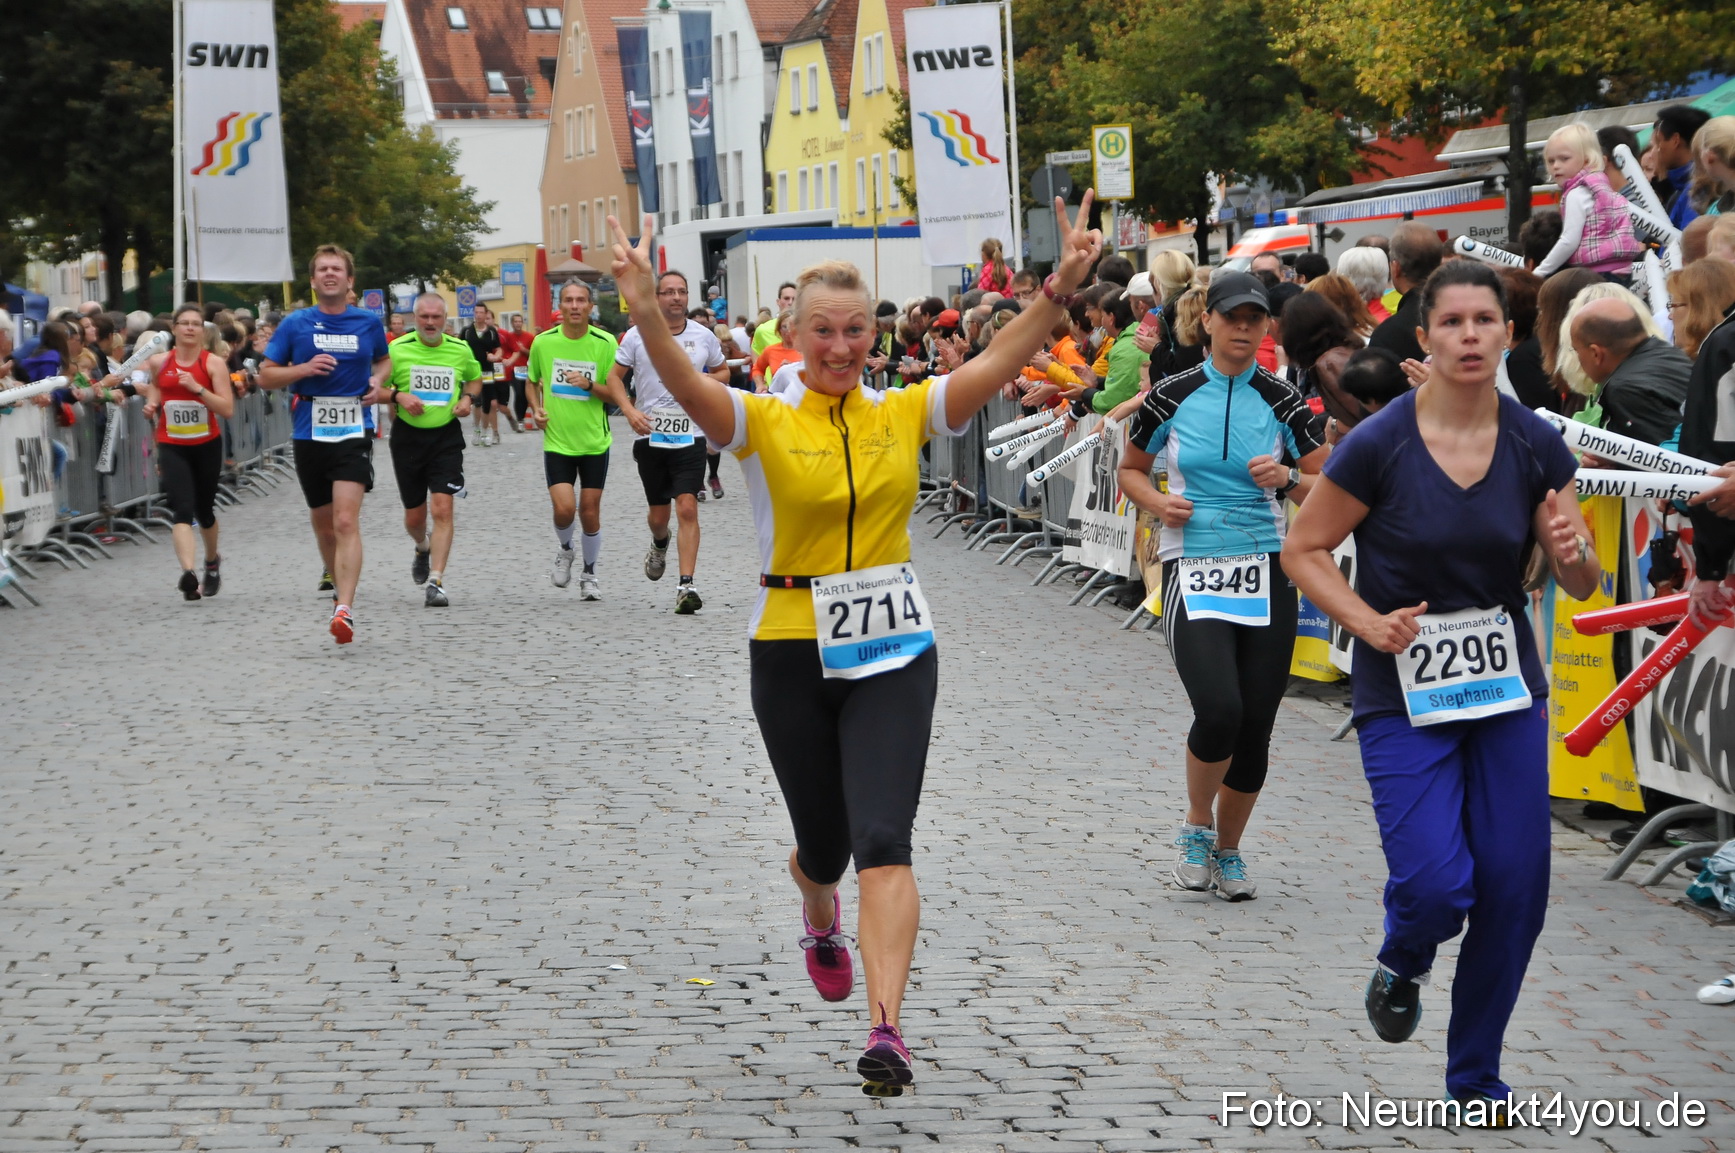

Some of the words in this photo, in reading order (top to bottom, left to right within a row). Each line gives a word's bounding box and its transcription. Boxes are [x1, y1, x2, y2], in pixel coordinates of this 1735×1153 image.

[187, 42, 269, 68] swn
[802, 137, 821, 159] HOTEL
[198, 225, 242, 235] tadtwerke
[245, 226, 285, 235] neumarkt
[1469, 226, 1506, 238] Bayer
[1482, 245, 1516, 265] BMW
[313, 333, 358, 344] HUBER
[414, 374, 450, 391] 3308
[173, 409, 200, 424] 608
[317, 407, 356, 424] 2911
[654, 418, 690, 433] 2260
[1006, 436, 1030, 451] BMW
[1047, 452, 1071, 474] BMW
[1180, 557, 1211, 568] PARTL
[1212, 554, 1253, 565] Neumarkt
[815, 584, 854, 598] PARTL
[856, 576, 902, 591] Neumarkt
[1189, 565, 1261, 594] 3349
[829, 590, 922, 640] 2714
[1438, 617, 1493, 633] Neumarkt
[858, 641, 902, 662] Ulrike
[1409, 631, 1508, 685] 2296
[1659, 636, 1689, 669] Audi
[1634, 668, 1663, 692] BKK
[1428, 684, 1506, 709] Stephanie
